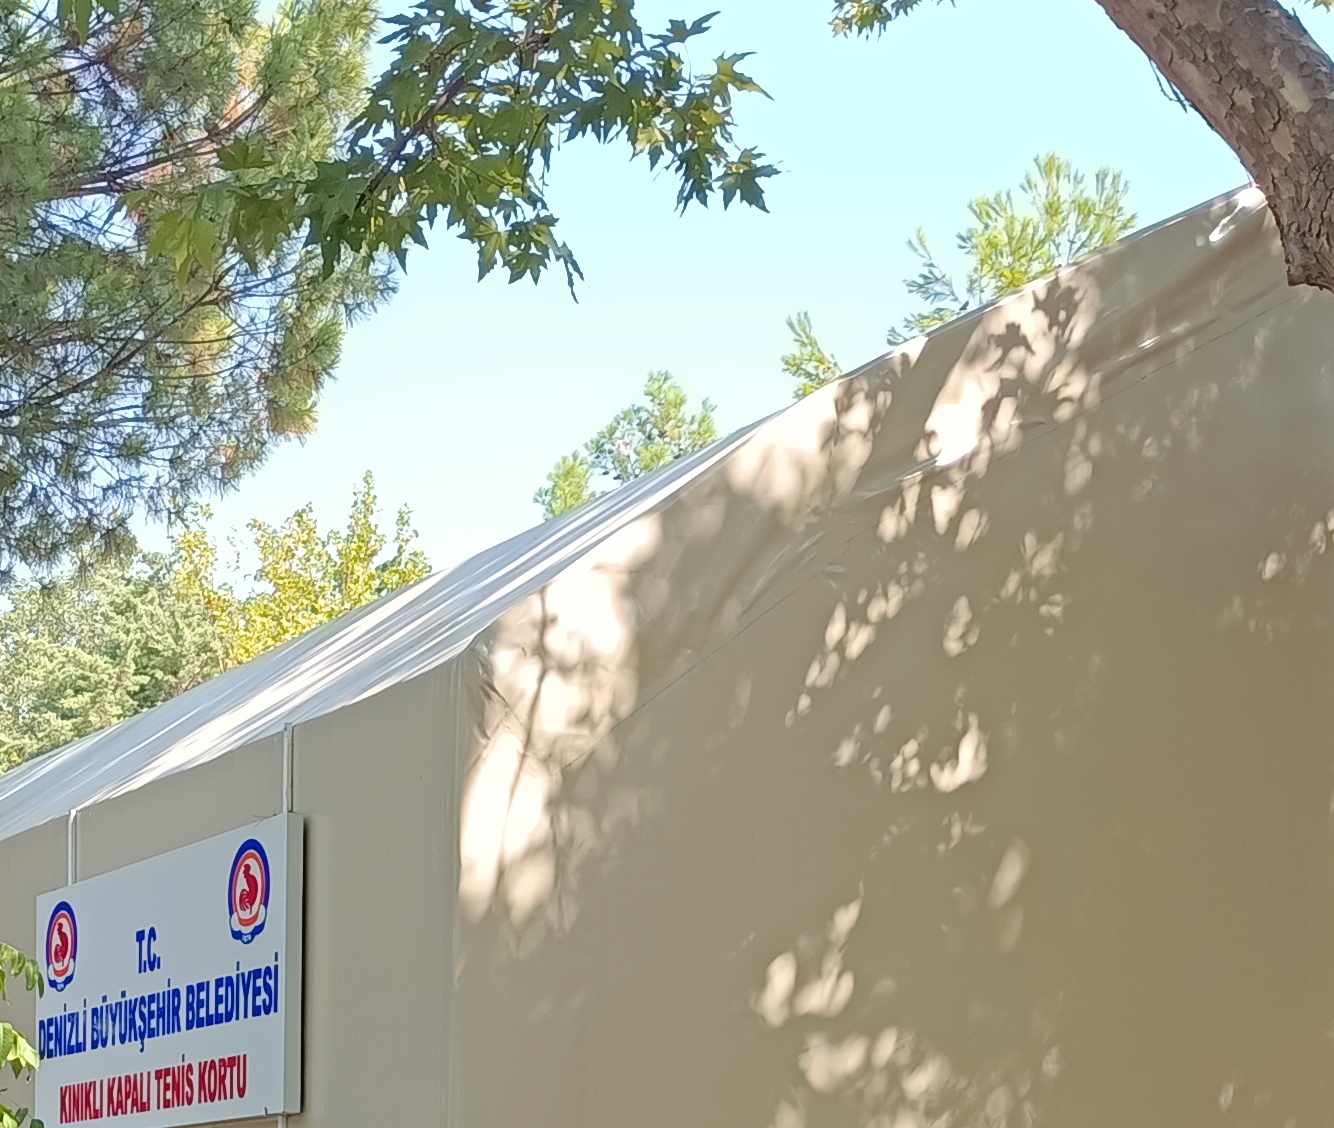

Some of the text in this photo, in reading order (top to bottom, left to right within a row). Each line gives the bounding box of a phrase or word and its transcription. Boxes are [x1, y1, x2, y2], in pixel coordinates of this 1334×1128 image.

[136, 926, 161, 974] T.C.
[38, 951, 279, 1060] DENİZLİ BÜYÜKŞEHİR BELEDİYESİ
[60, 1054, 247, 1124] KINIKLI KAPALI TENİS KORTU
